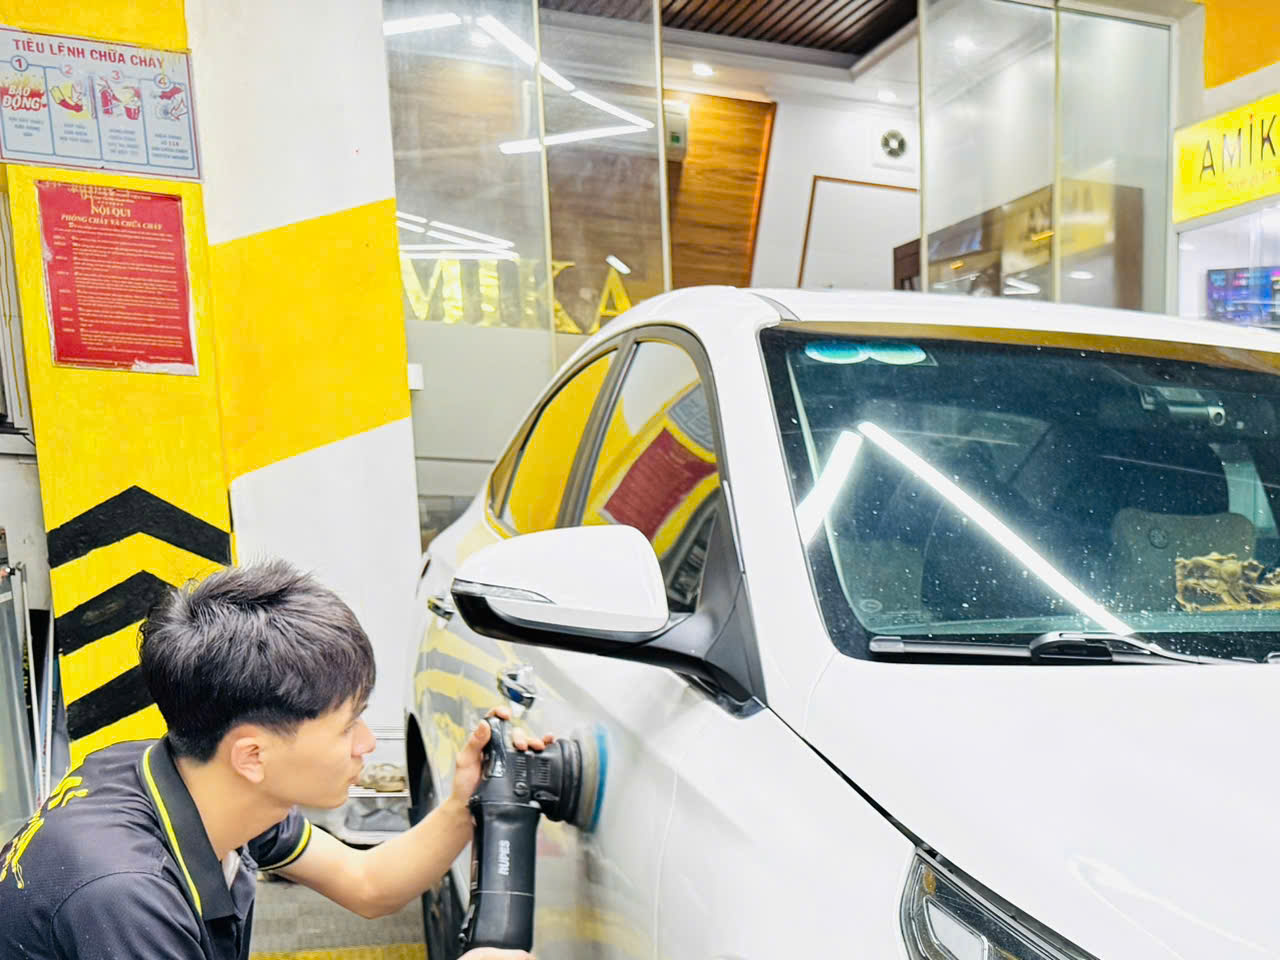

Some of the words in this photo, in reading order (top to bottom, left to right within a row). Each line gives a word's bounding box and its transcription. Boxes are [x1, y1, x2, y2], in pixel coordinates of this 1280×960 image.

[12, 38, 45, 53] TIÊU
[15, 58, 23, 69] 1
[64, 64, 73, 75] 2
[112, 70, 121, 81] 3
[498, 839, 511, 876] RUPES
